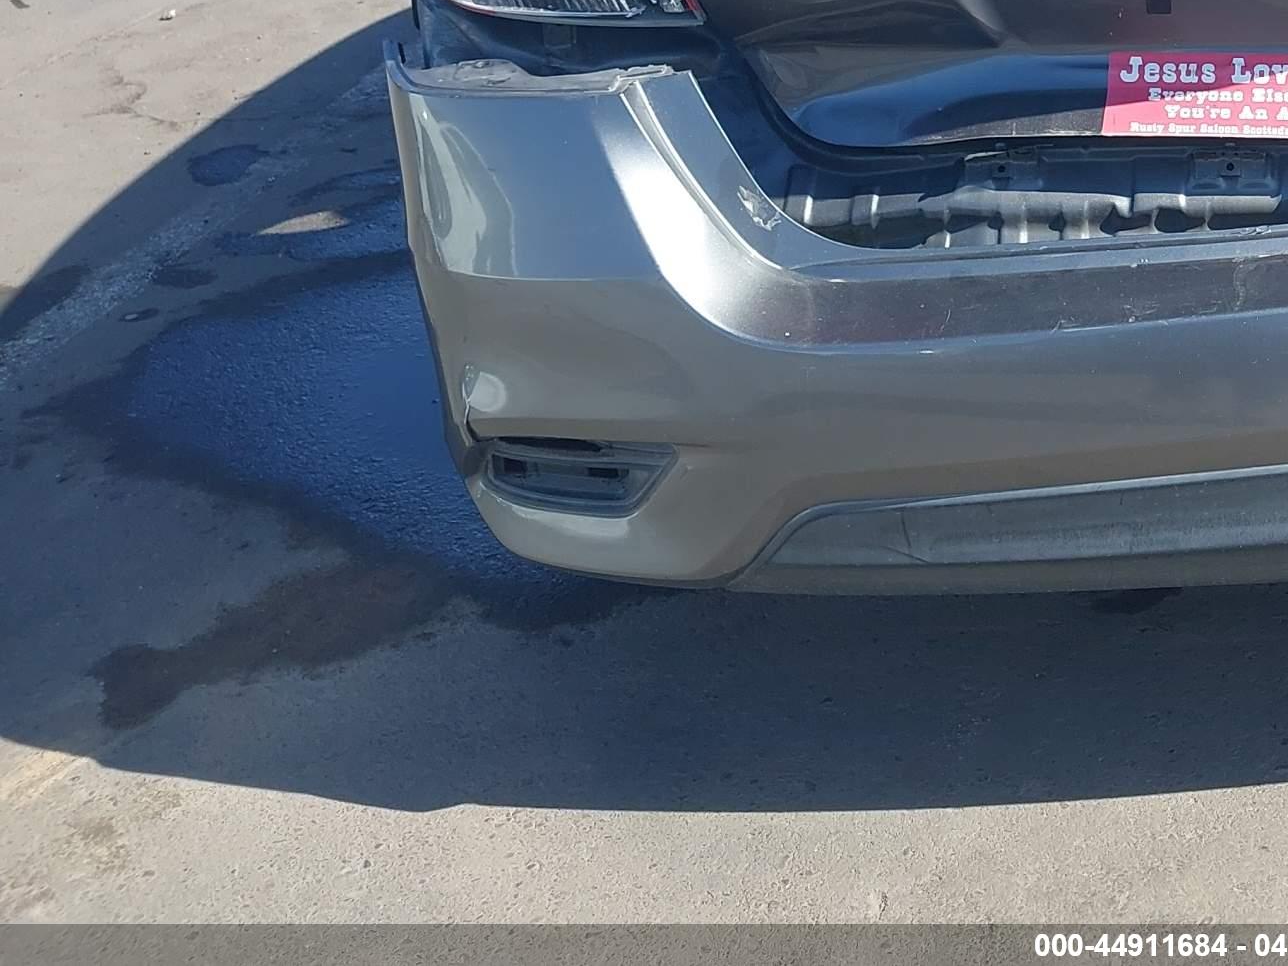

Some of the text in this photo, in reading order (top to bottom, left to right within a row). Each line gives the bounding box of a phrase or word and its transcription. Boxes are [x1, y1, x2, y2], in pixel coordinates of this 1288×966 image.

[1119, 56, 1217, 84] Jesus
[1148, 87, 1244, 104] Everyone
[1164, 104, 1231, 120] You're
[1238, 105, 1268, 121] An
[1130, 121, 1165, 134] Rusty
[1168, 123, 1197, 135] Spur
[1200, 123, 1239, 135] Saloon
